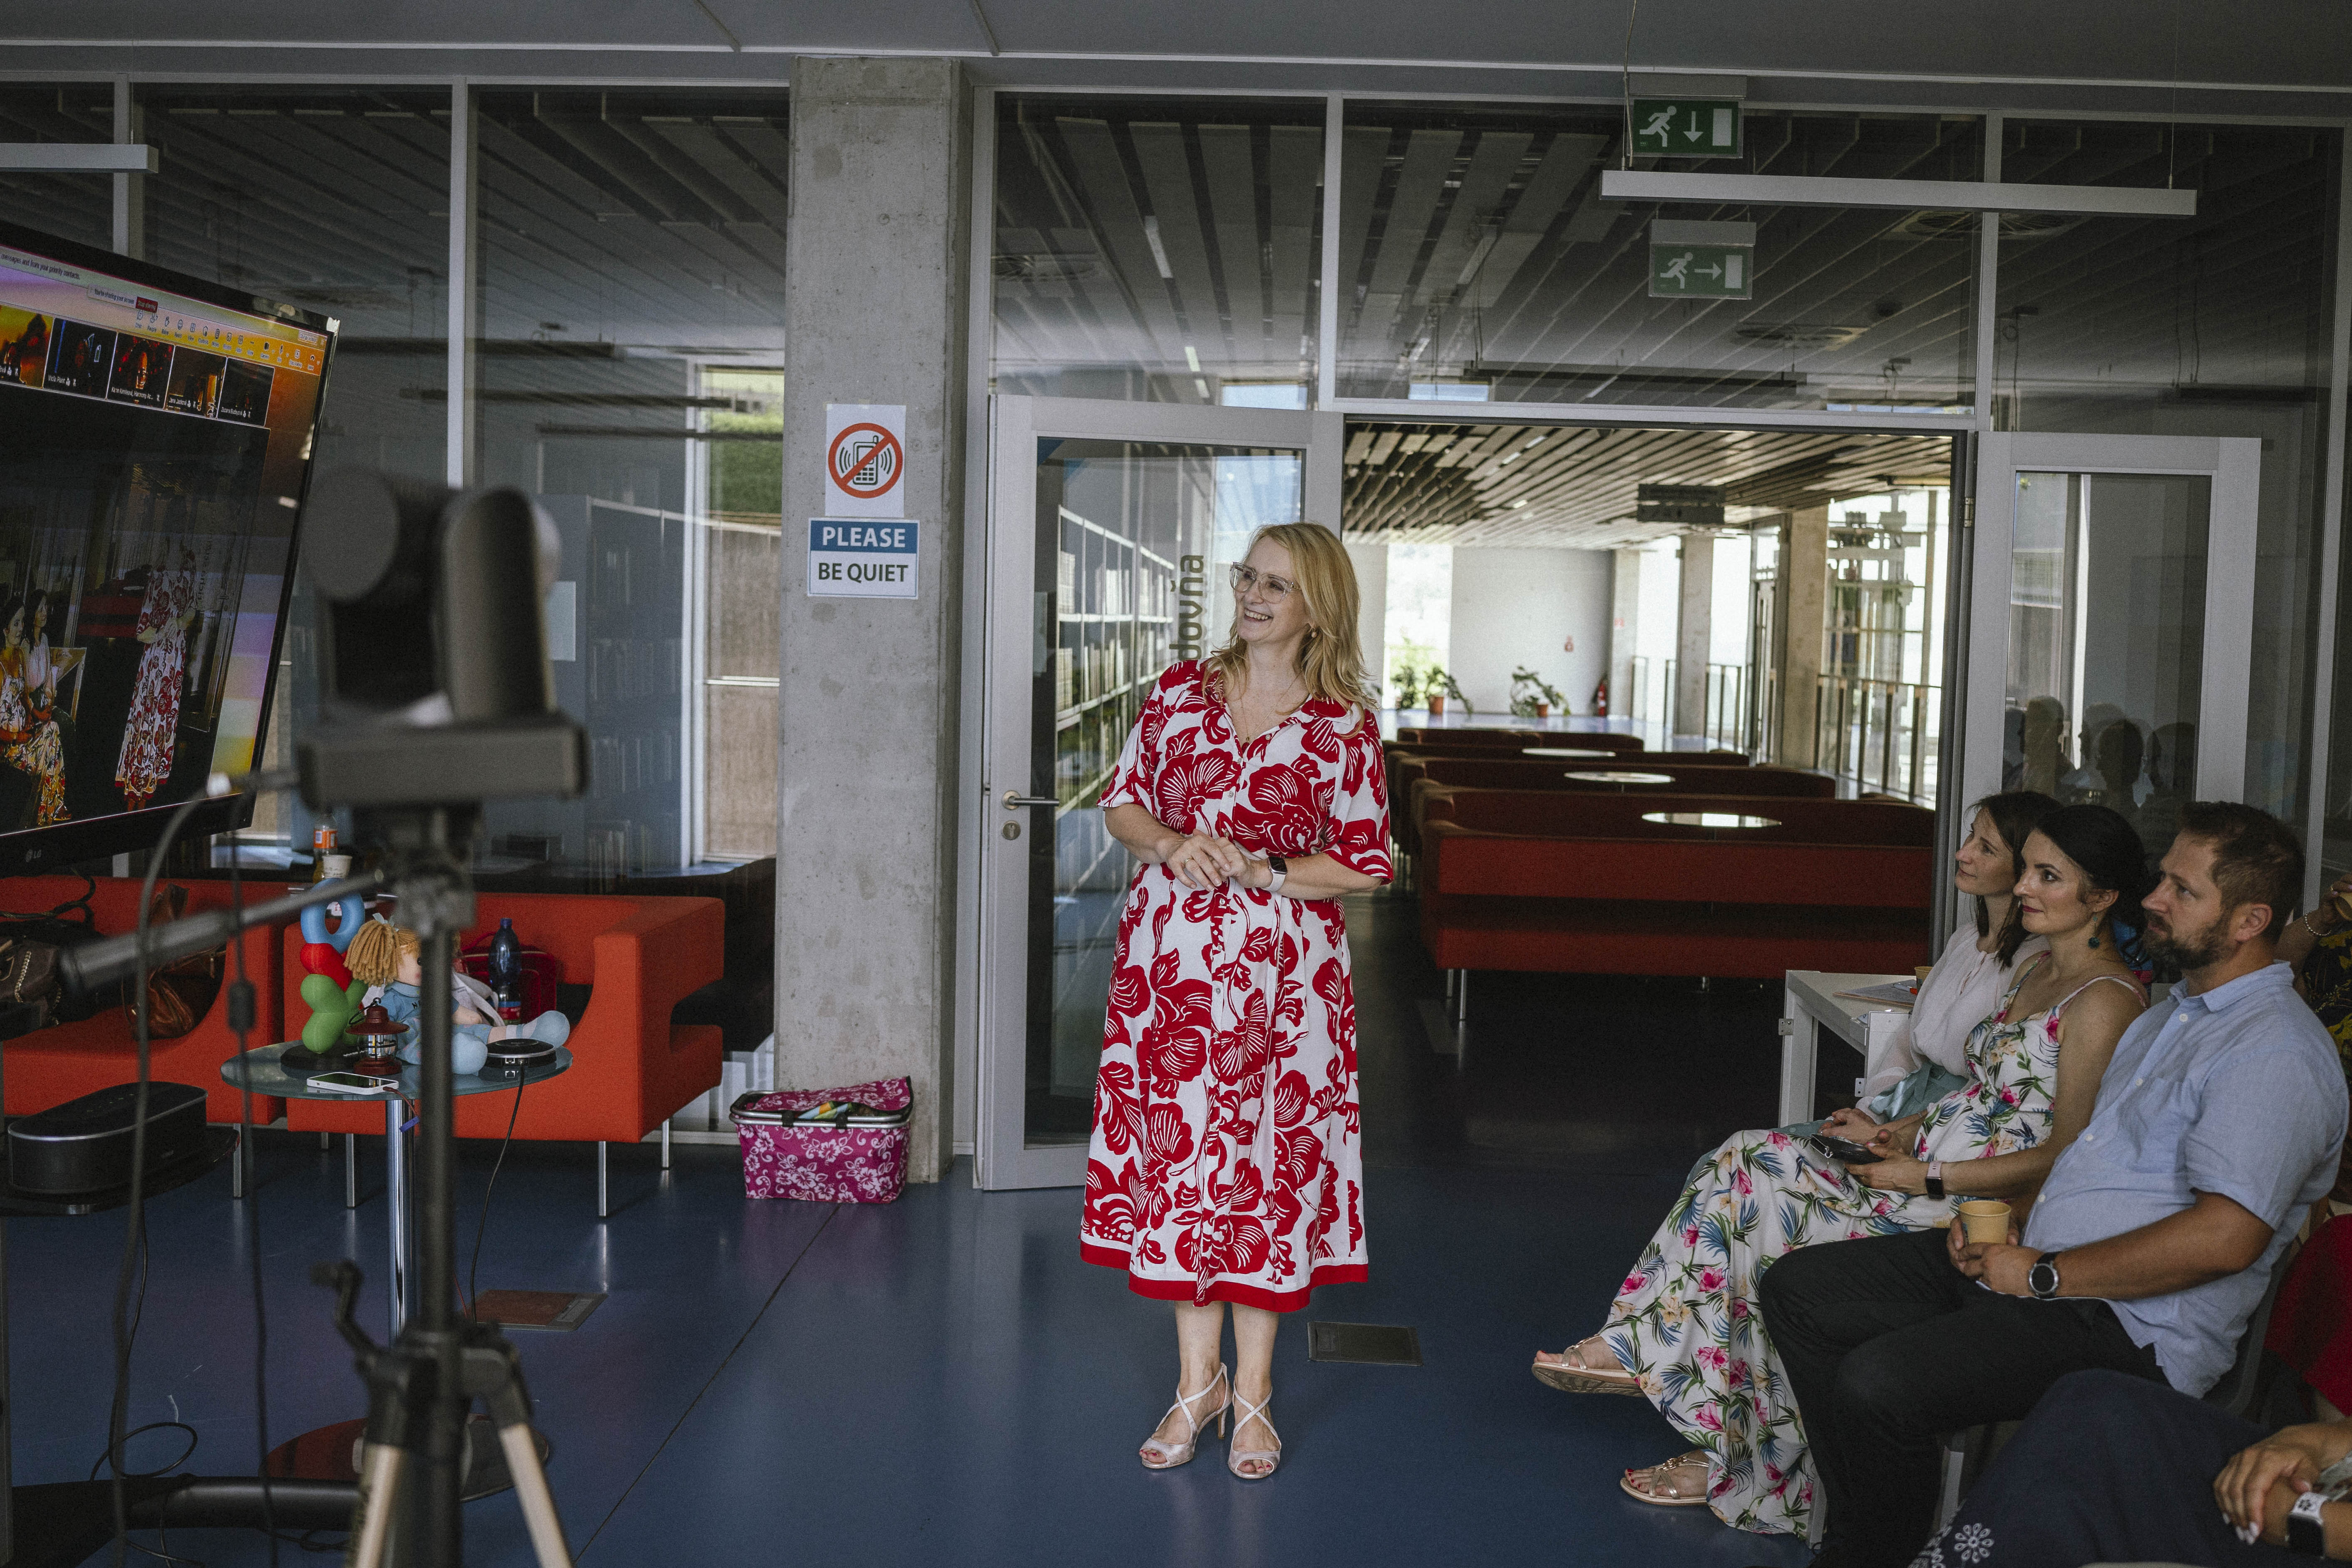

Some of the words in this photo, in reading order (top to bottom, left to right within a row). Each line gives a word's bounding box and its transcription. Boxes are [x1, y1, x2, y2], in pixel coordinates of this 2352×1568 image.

[1, 253, 21, 264] messages
[30, 260, 40, 268] from
[49, 266, 63, 276] priority
[822, 527, 906, 548] PLEASE
[818, 562, 842, 580] BE
[847, 562, 909, 584] QUIET
[1169, 554, 1204, 660] dovňa
